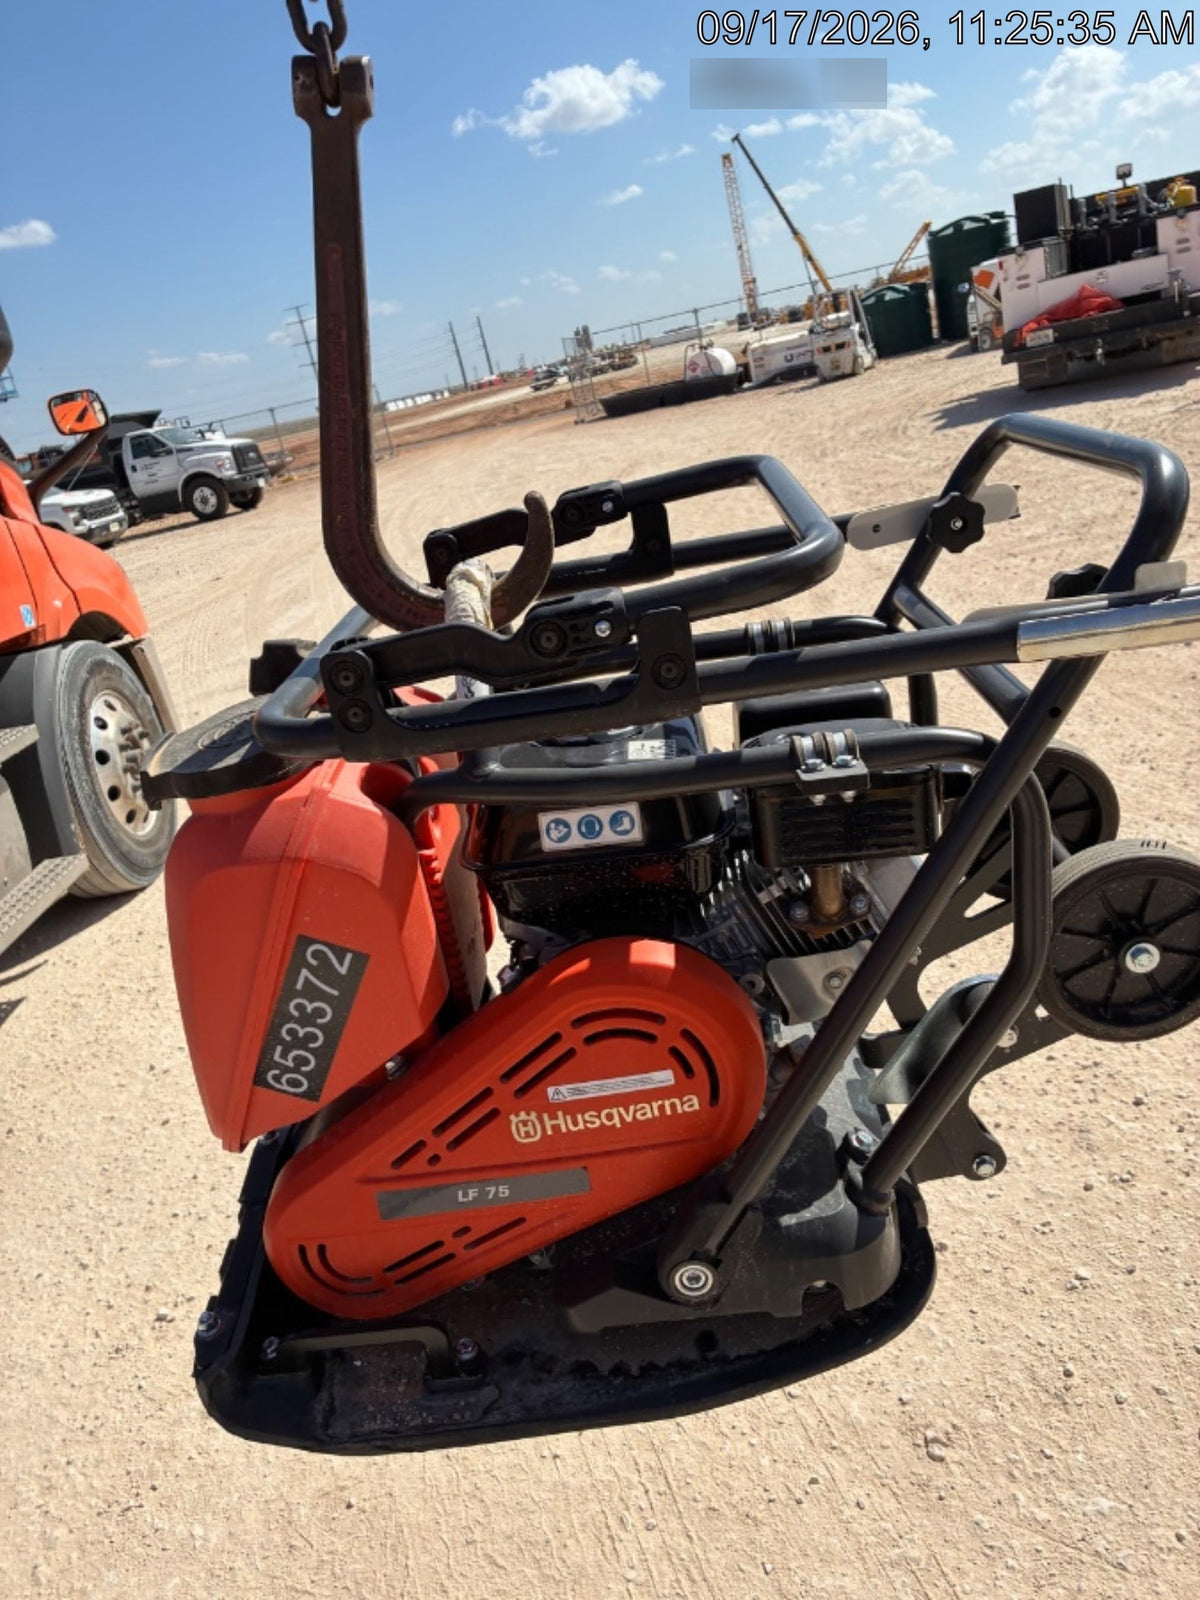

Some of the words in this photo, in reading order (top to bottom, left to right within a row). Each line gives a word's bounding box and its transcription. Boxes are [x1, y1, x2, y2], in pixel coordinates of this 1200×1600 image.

[266, 943, 353, 1094] 653372
[543, 1095, 700, 1134] Husqvarna
[457, 1188, 479, 1203] LF
[484, 1185, 510, 1200] 75
